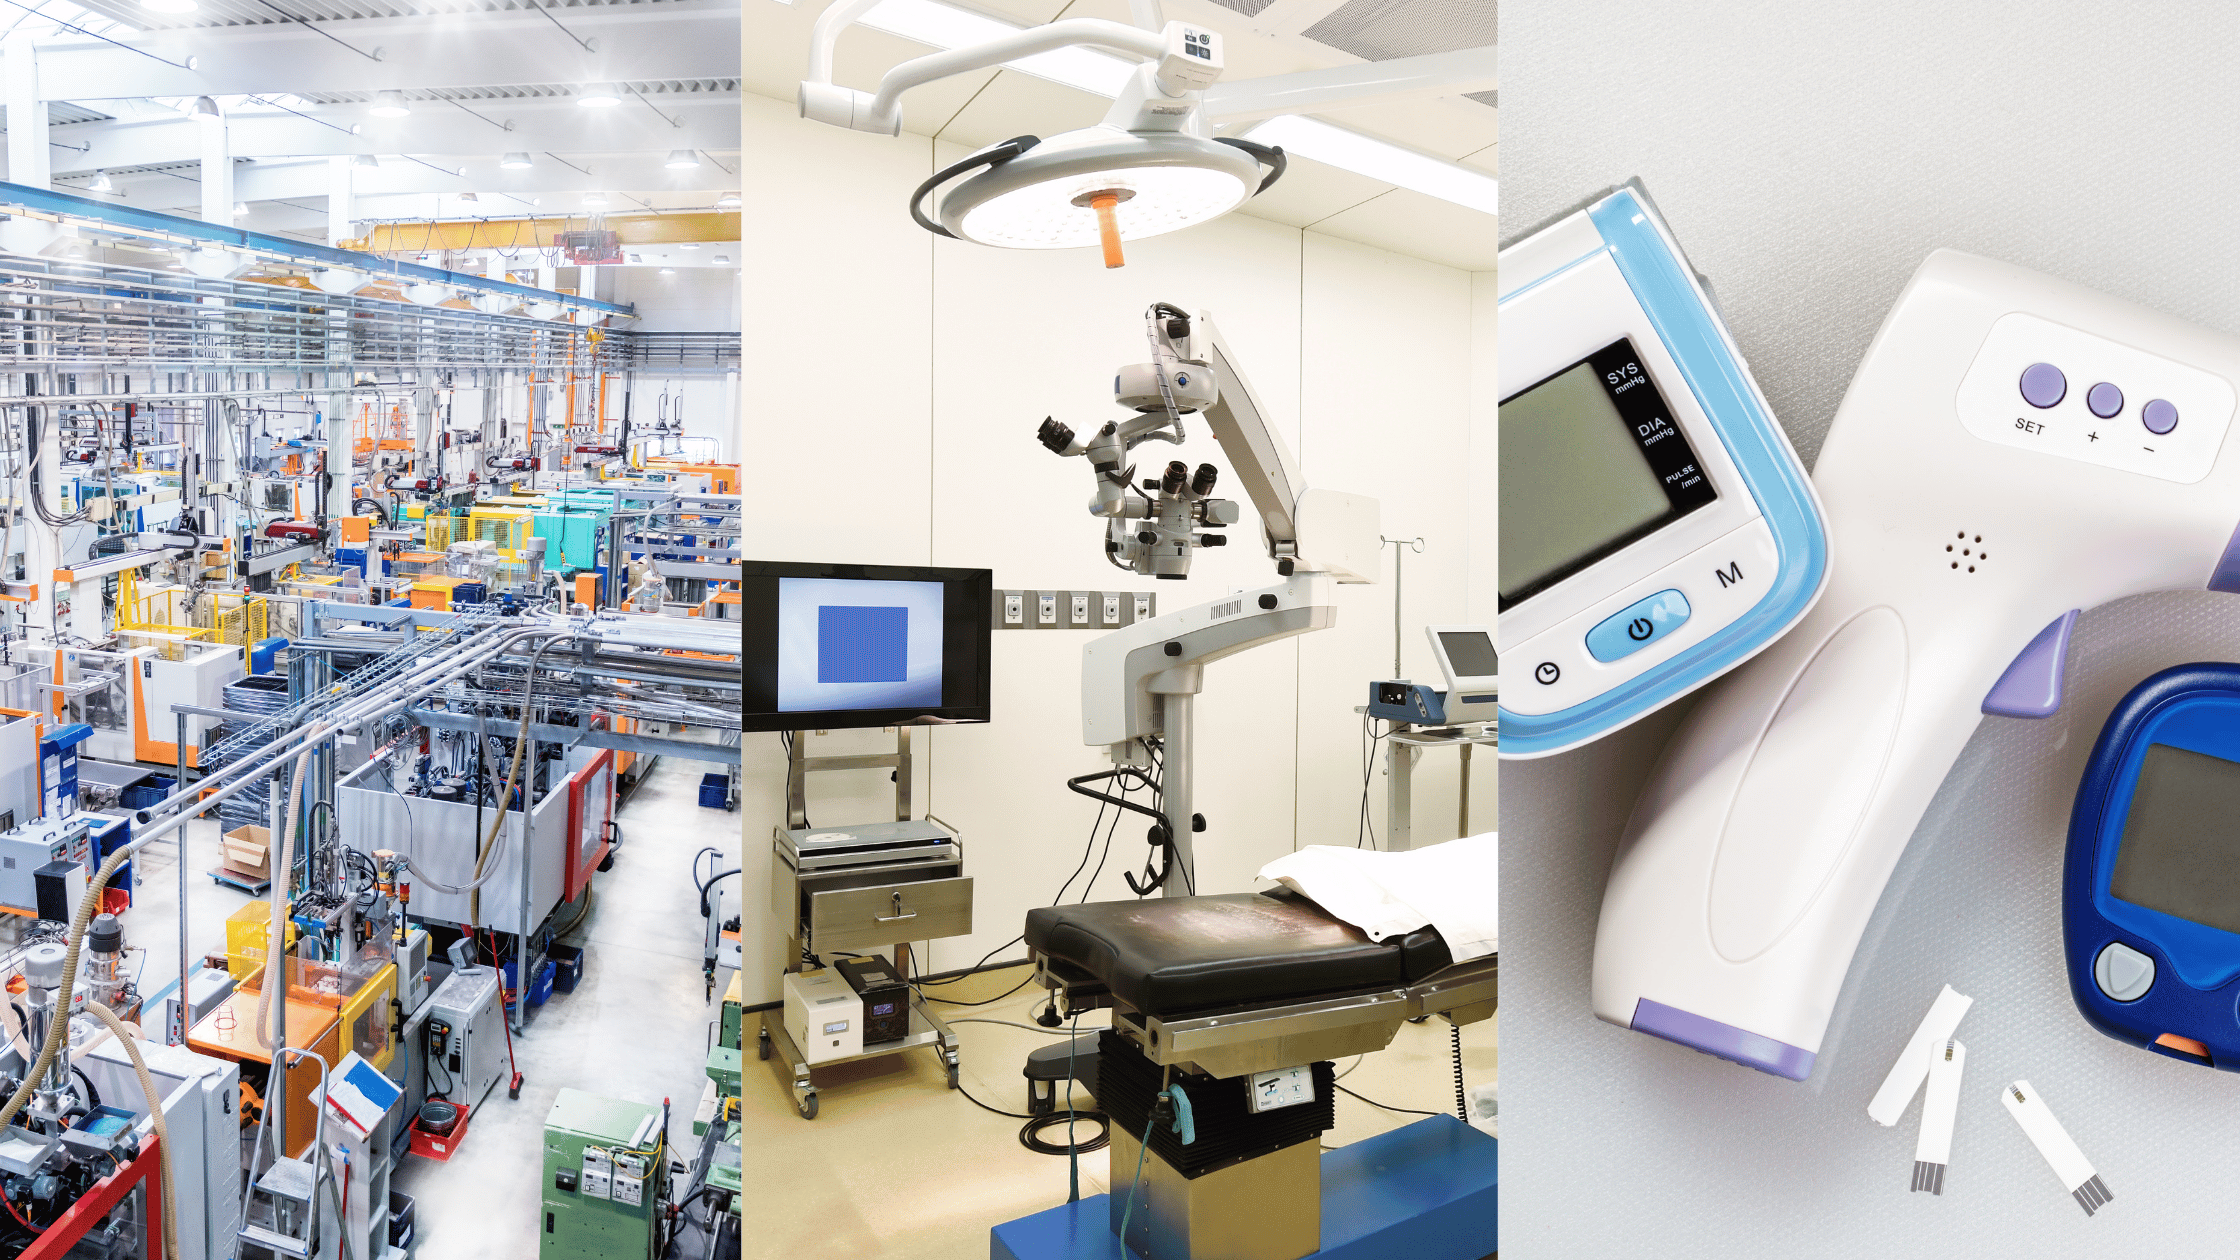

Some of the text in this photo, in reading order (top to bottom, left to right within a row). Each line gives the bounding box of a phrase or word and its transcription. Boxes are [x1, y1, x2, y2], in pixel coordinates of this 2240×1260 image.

[1607, 362, 1639, 385] SYS
[1615, 375, 1646, 395] mmHg
[1637, 417, 1667, 437] DIA
[2015, 417, 2045, 436] SET
[1644, 427, 1675, 447] mmHg
[1665, 464, 1695, 484] PULSE
[1681, 475, 1701, 490] /min
[1715, 561, 1744, 589] M
